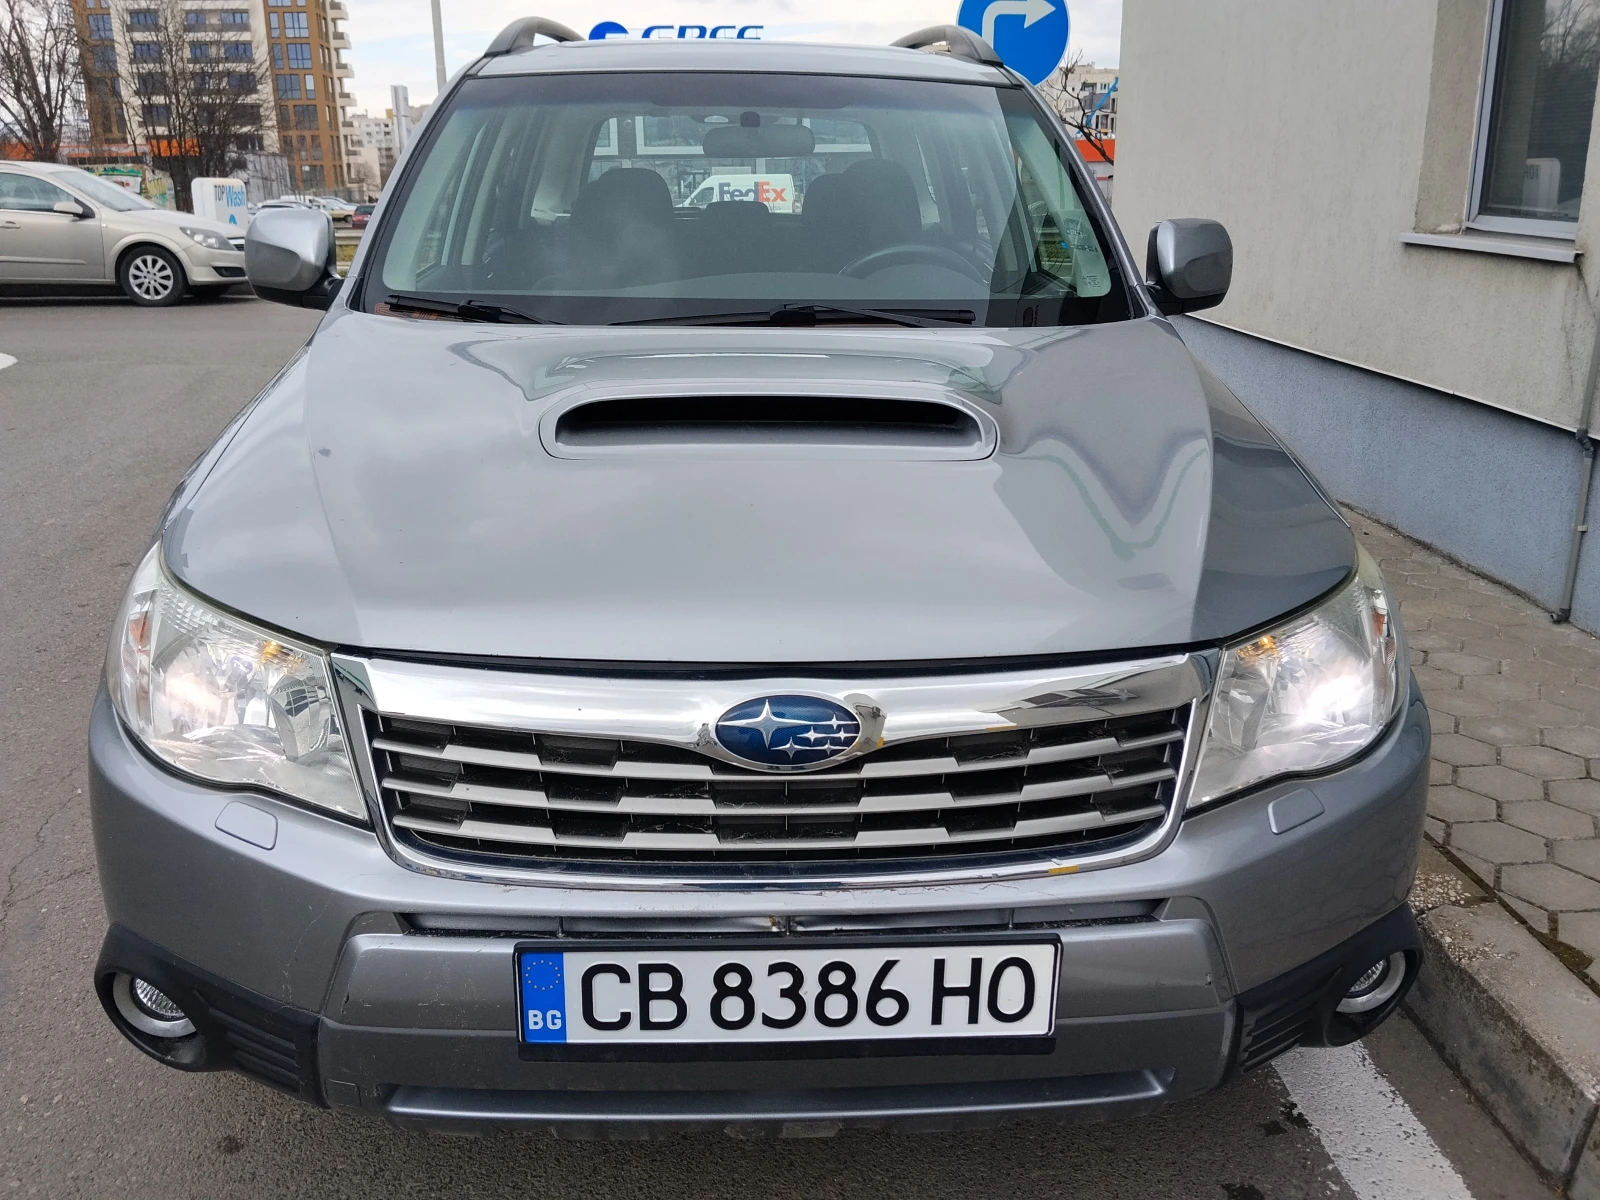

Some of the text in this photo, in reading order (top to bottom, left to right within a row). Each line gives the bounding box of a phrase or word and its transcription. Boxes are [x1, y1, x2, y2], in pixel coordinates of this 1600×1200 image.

[214, 185, 246, 207] TOP Wash
[718, 181, 788, 202] FedEx
[580, 956, 1036, 1032] CB 8386 HO
[528, 1009, 562, 1030] BG
